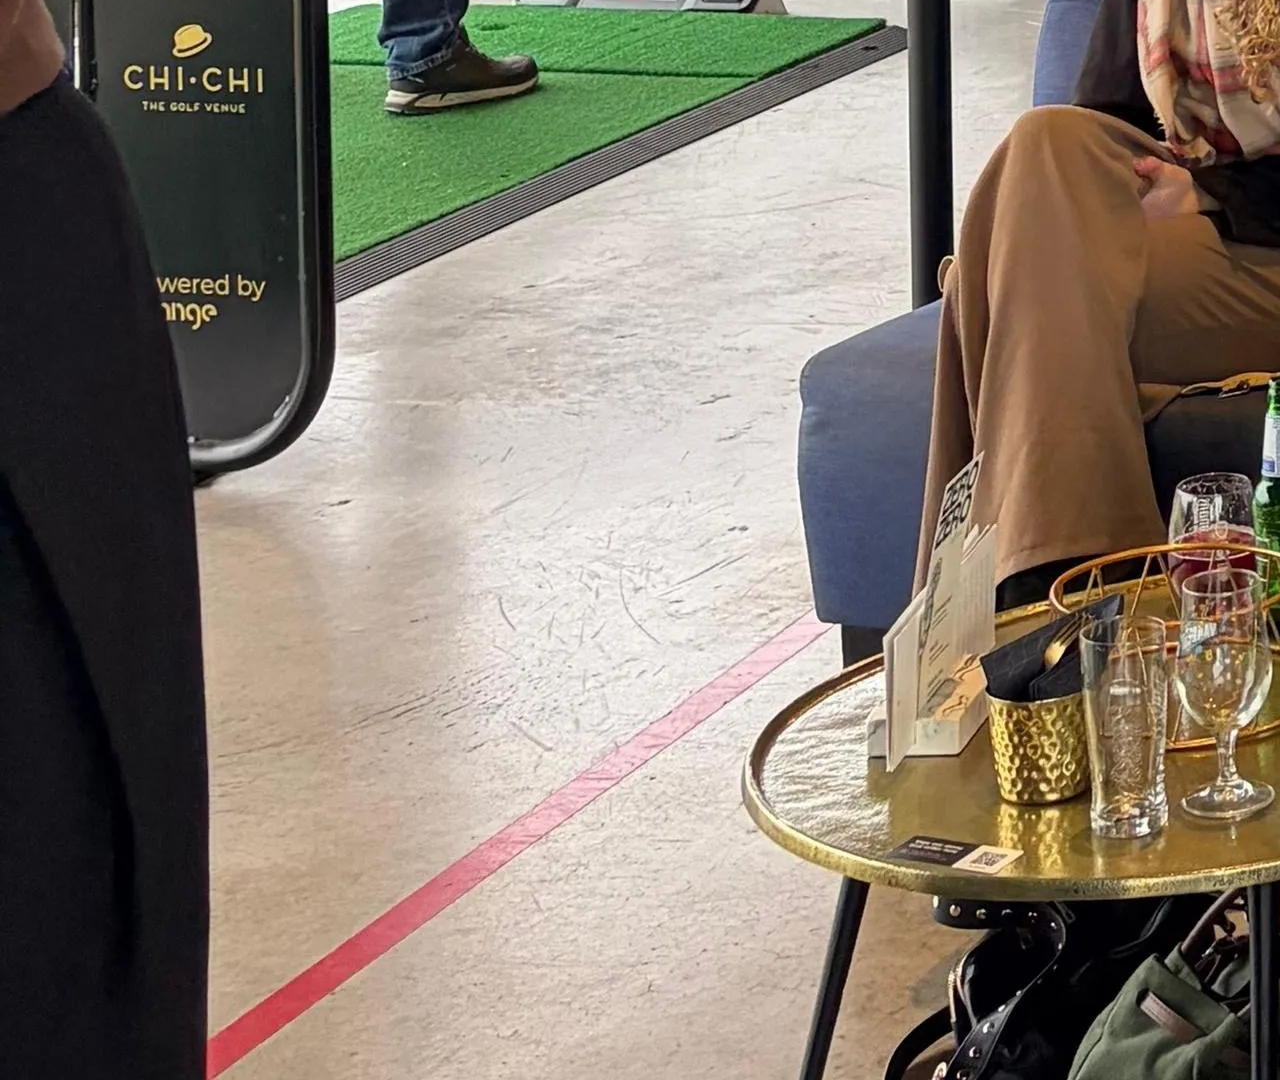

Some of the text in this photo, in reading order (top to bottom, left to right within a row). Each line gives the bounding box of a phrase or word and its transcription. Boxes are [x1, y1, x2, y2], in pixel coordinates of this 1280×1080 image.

[142, 100, 246, 114] THE GOLF VENUE
[157, 274, 267, 302] wered by
[942, 460, 979, 517] ZERO
[934, 492, 972, 550] ZERO
